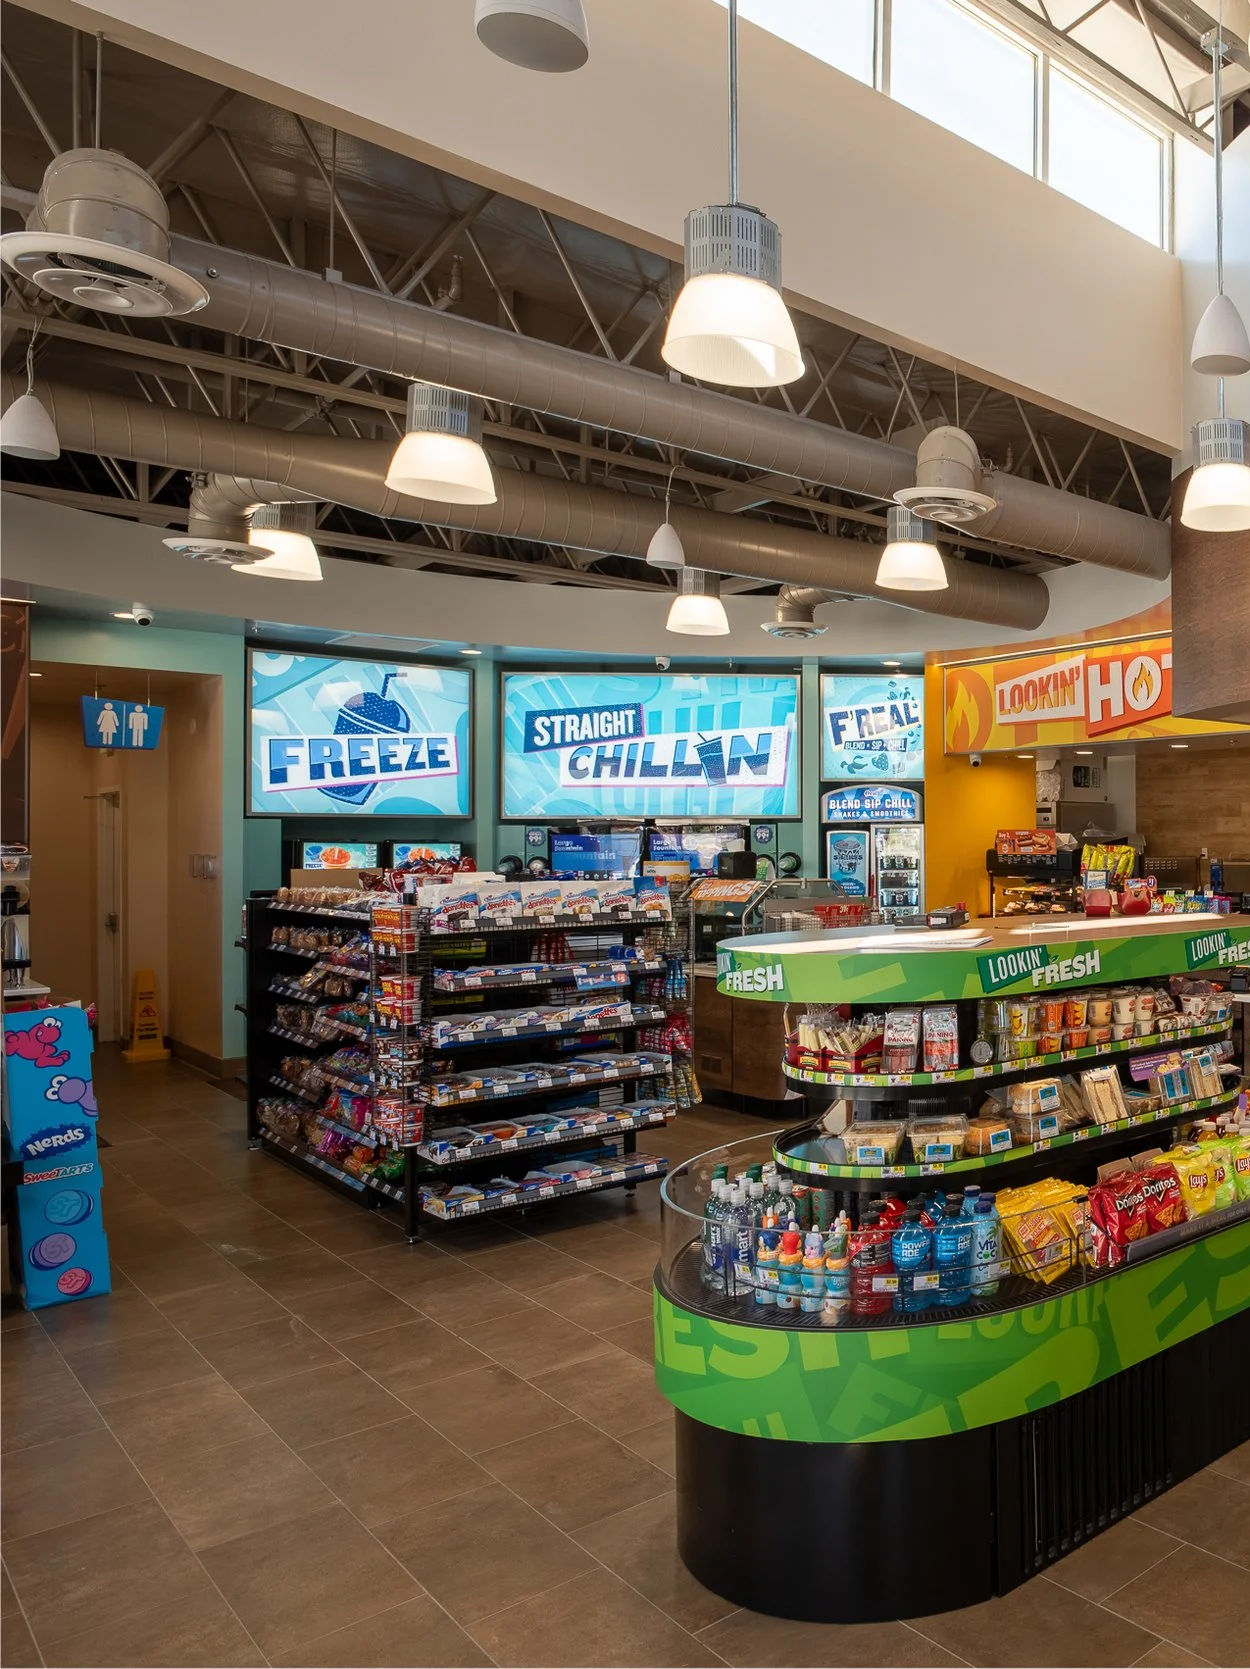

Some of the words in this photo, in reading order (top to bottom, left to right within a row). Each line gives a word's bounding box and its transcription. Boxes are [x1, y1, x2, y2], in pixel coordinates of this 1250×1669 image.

[998, 659, 1081, 717] LOOKIN'
[532, 708, 637, 748] STRAIGHT
[829, 702, 920, 746] F'REAL
[844, 740, 866, 750] BLEND
[871, 739, 883, 750] SIP
[887, 738, 906, 751] CHILL
[268, 737, 451, 785] FREEZE
[829, 799, 861, 810] BLEND
[864, 799, 881, 809] SIP
[884, 799, 912, 809] CHILL
[870, 810, 909, 818] SMOOTHIES
[1191, 931, 1227, 961] LOOKIN'
[725, 963, 784, 993] FRESH
[988, 947, 1044, 984] LOOKIN'
[1031, 949, 1101, 988] FRESH
[26, 1126, 85, 1157] Nerds
[1143, 1178, 1177, 1199] Doritos
[1188, 1173, 1208, 1188] Lay's
[977, 1239, 997, 1251] VITA
